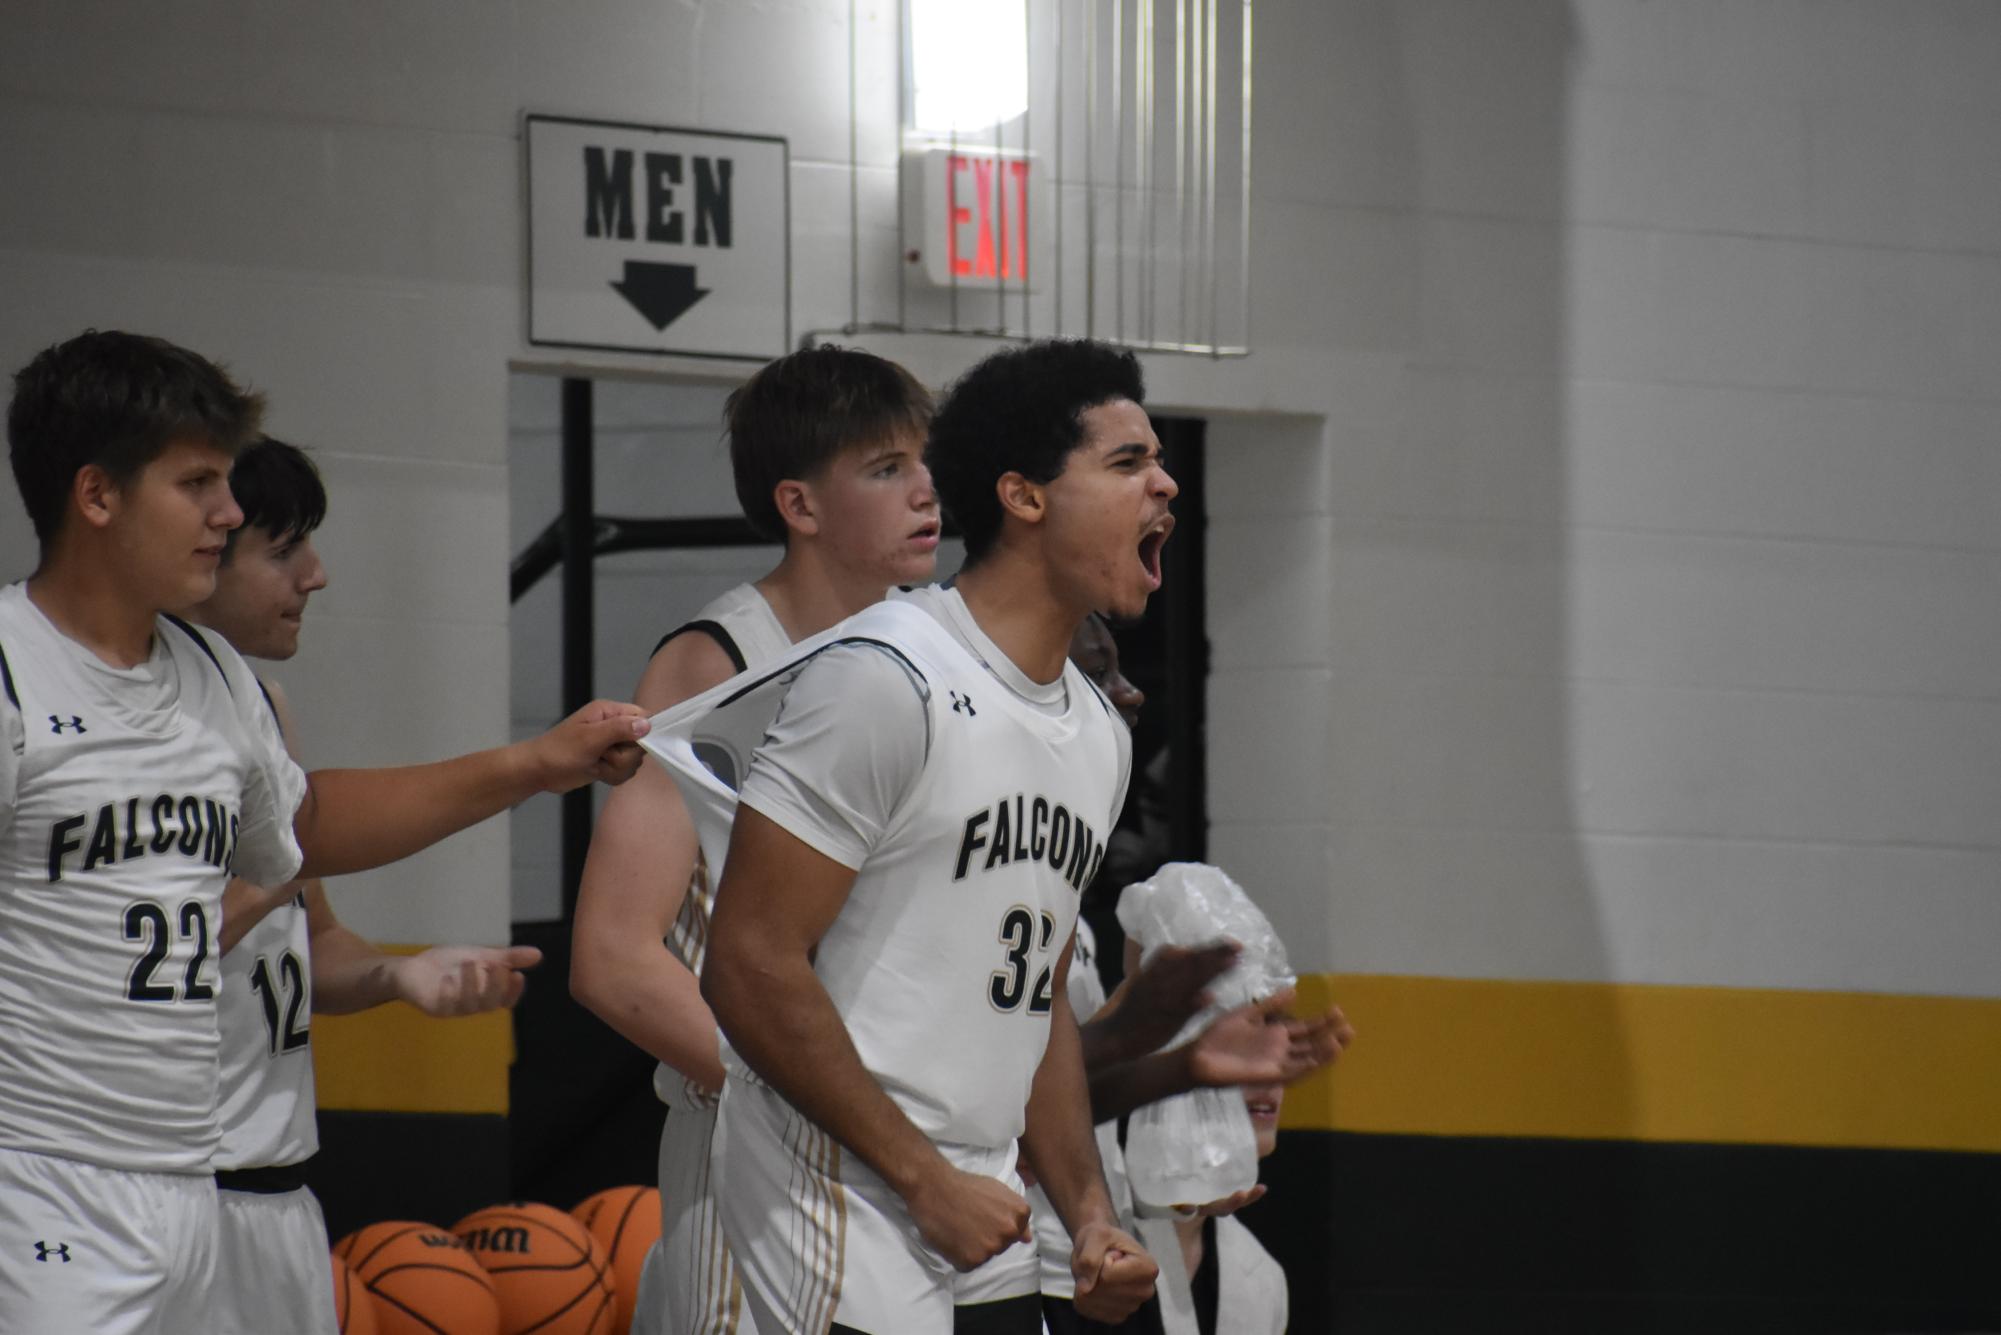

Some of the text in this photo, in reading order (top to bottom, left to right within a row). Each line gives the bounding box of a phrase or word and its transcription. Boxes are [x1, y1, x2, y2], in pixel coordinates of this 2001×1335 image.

[583, 145, 734, 248] MEN
[946, 156, 1029, 281] EXIT
[121, 898, 217, 1004] 22
[250, 946, 310, 1057] 12
